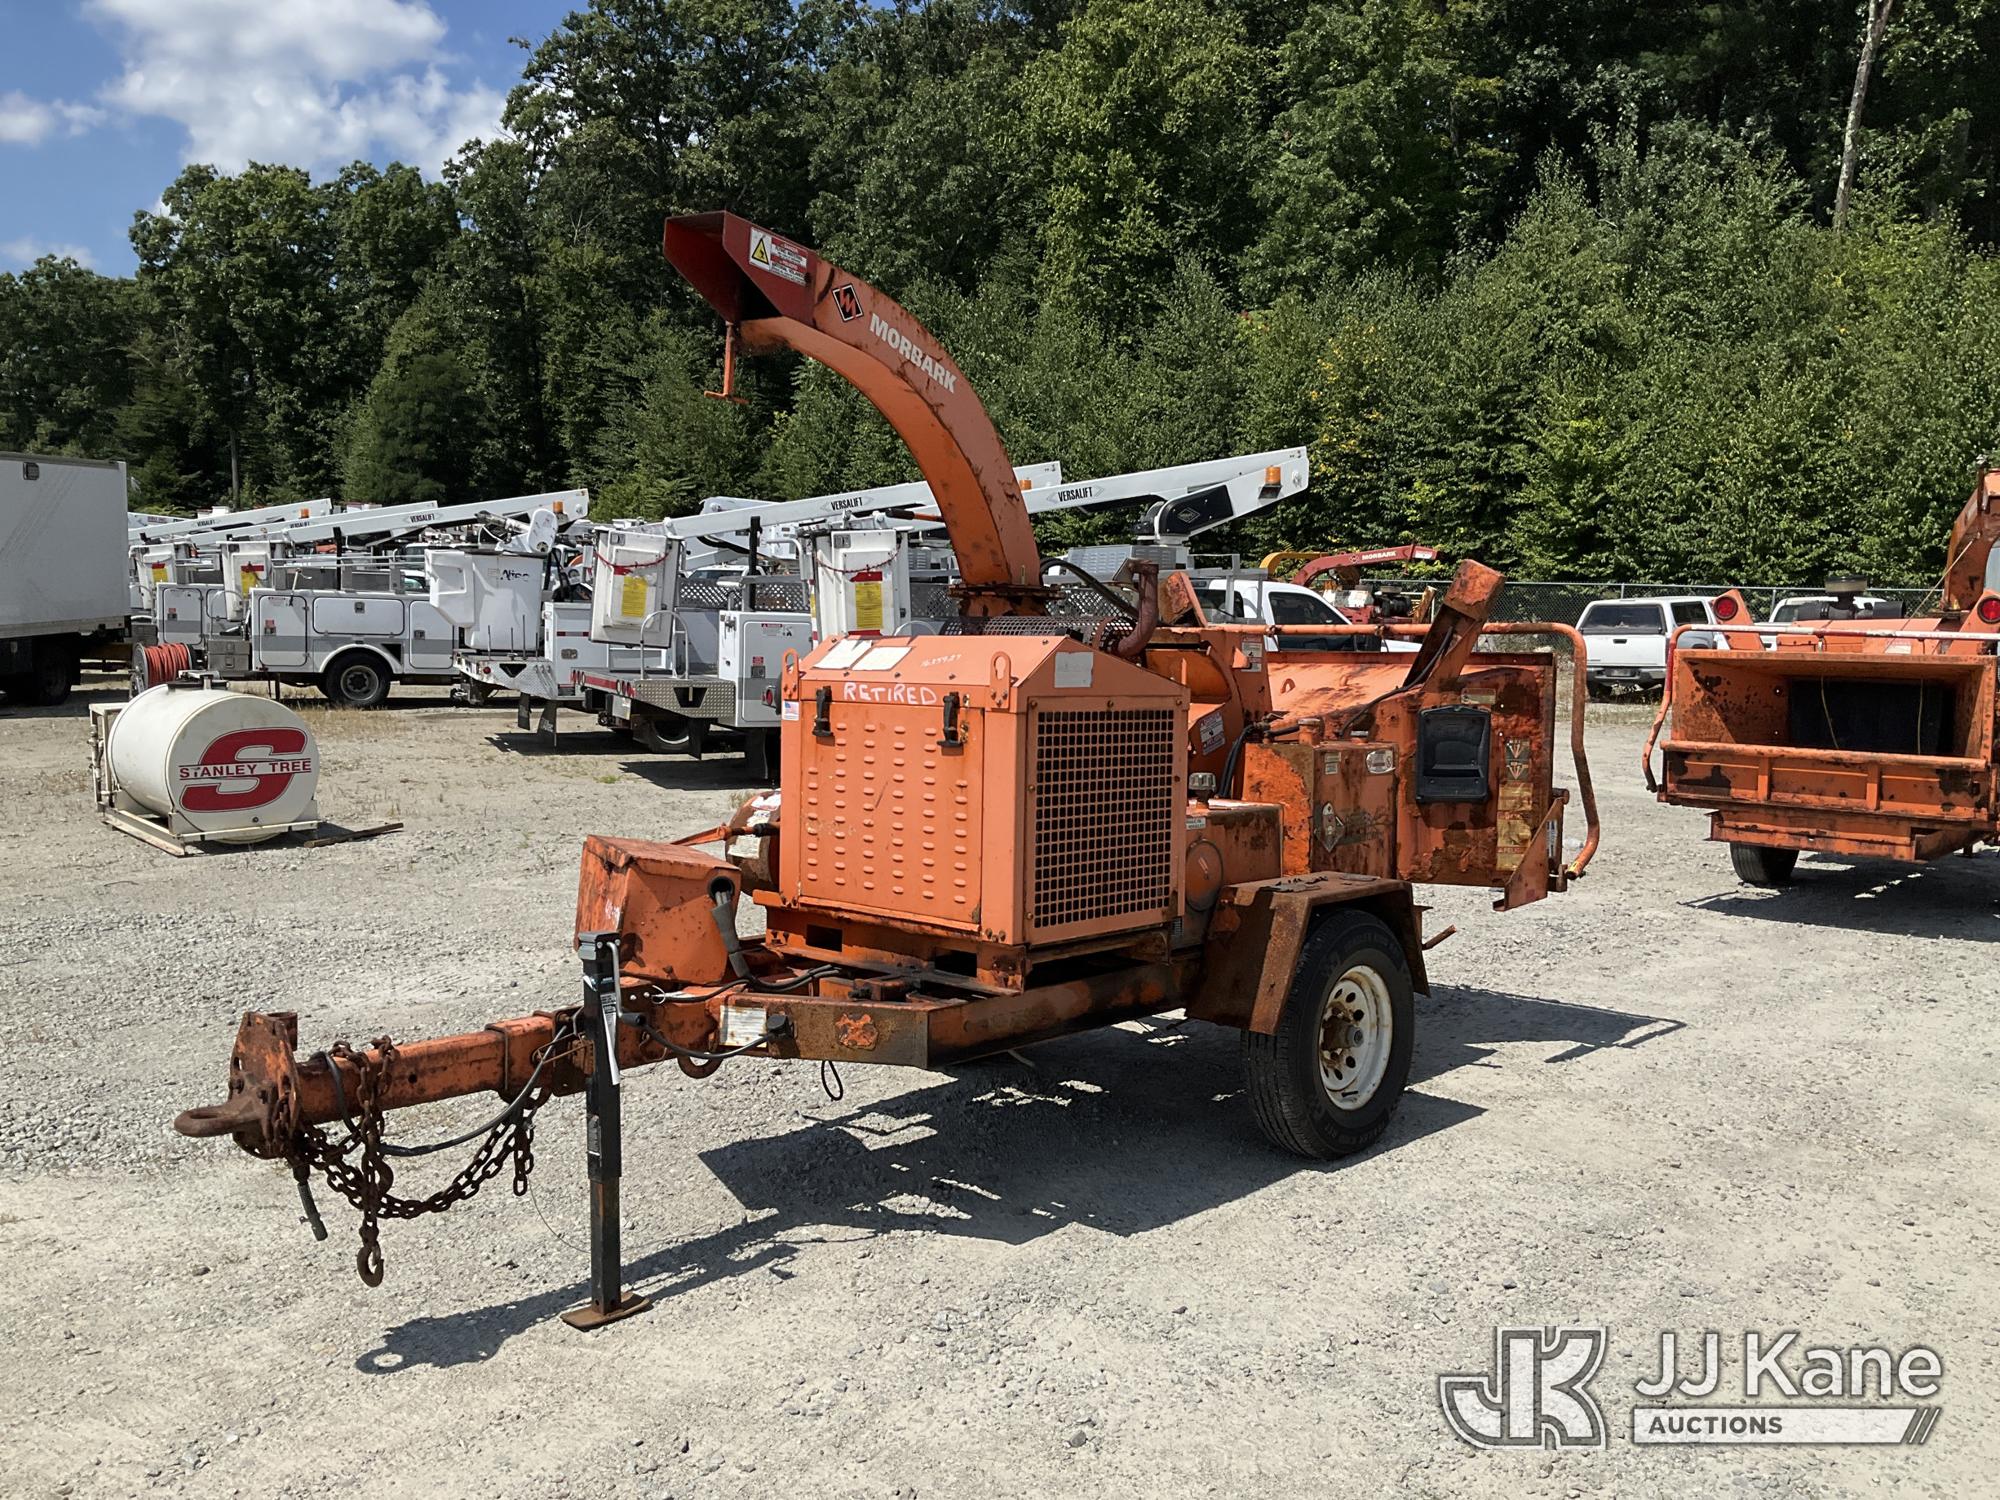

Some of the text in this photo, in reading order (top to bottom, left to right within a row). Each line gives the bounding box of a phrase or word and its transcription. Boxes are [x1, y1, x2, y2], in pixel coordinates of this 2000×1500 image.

[869, 312, 957, 394] MORBARK
[1057, 486, 1093, 502] VERSALIFT
[830, 496, 863, 511] VERSALIFT
[410, 513, 435, 523] VERSALIFT
[1361, 550, 1397, 561] MORBARK
[843, 681, 937, 705] RETIRED
[179, 760, 312, 779] STANLEY TREE
